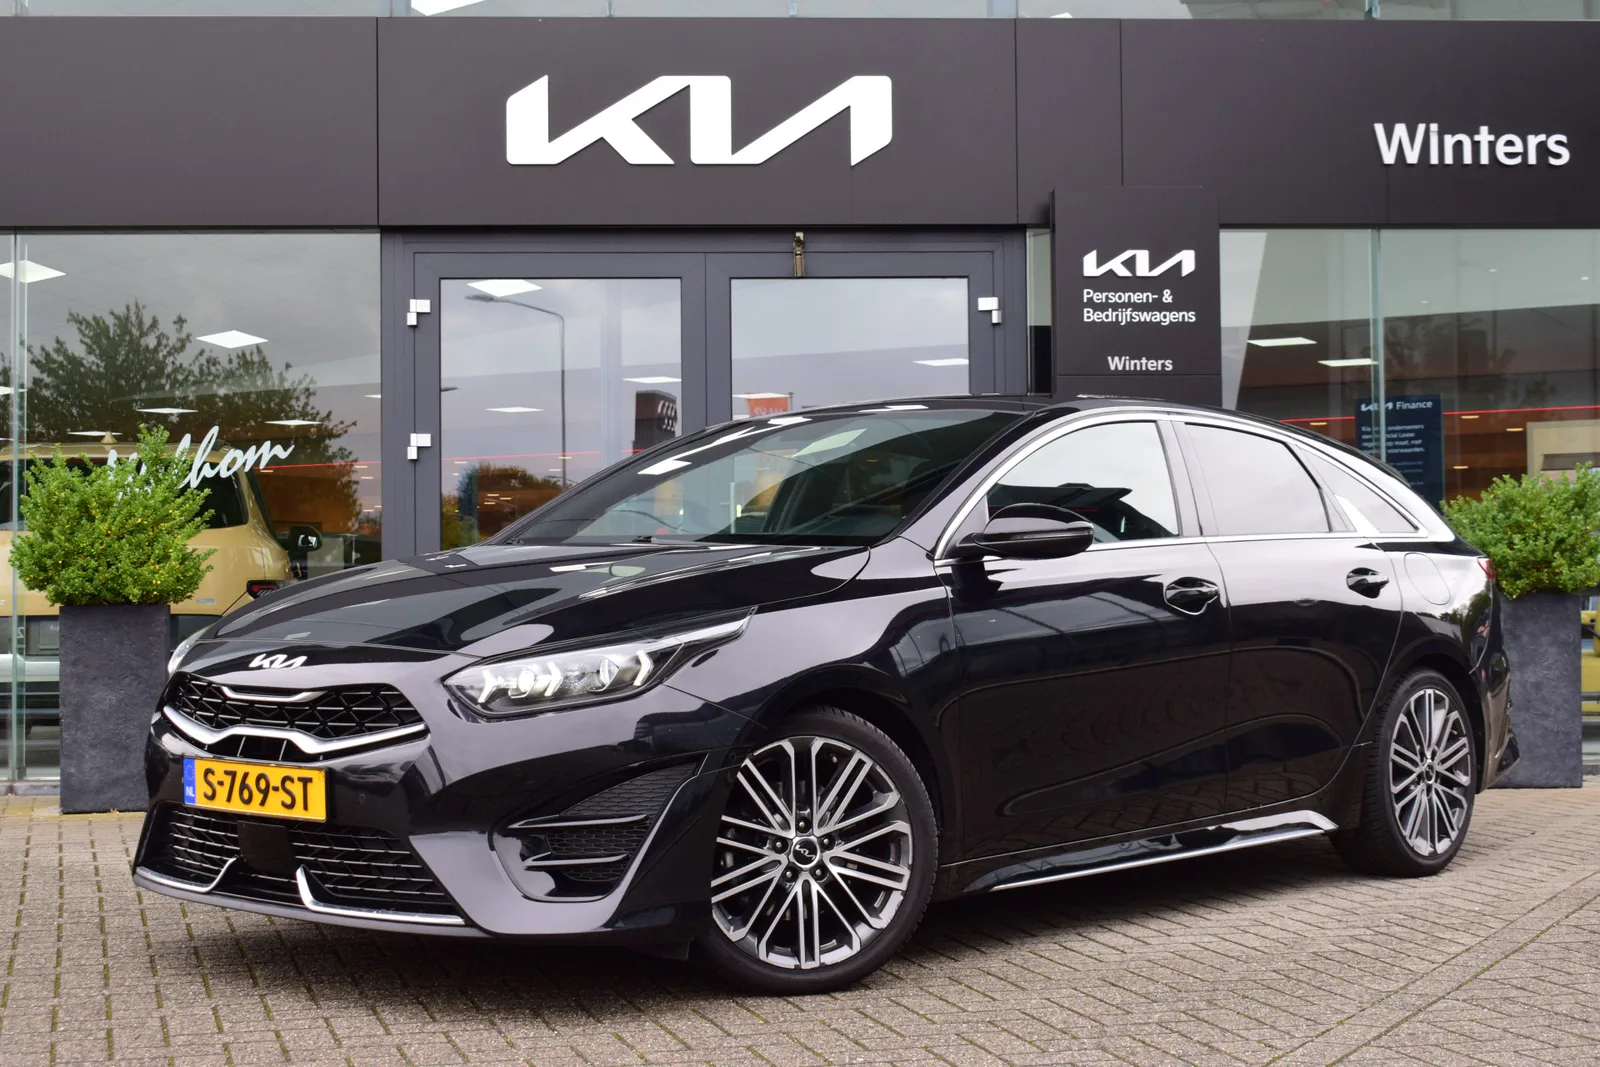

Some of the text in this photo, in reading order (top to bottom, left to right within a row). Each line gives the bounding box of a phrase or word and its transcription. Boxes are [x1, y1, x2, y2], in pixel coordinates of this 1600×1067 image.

[506, 75, 893, 166] KIA
[1373, 122, 1571, 167] Winters
[1083, 249, 1196, 277] KIA
[1083, 288, 1173, 304] Personen- &
[1083, 308, 1197, 326] Bedrijfswagens
[1107, 355, 1174, 371] Winters
[1396, 400, 1433, 410] Finance
[248, 653, 309, 669] KIA
[185, 767, 314, 812] NL S-769-ST
